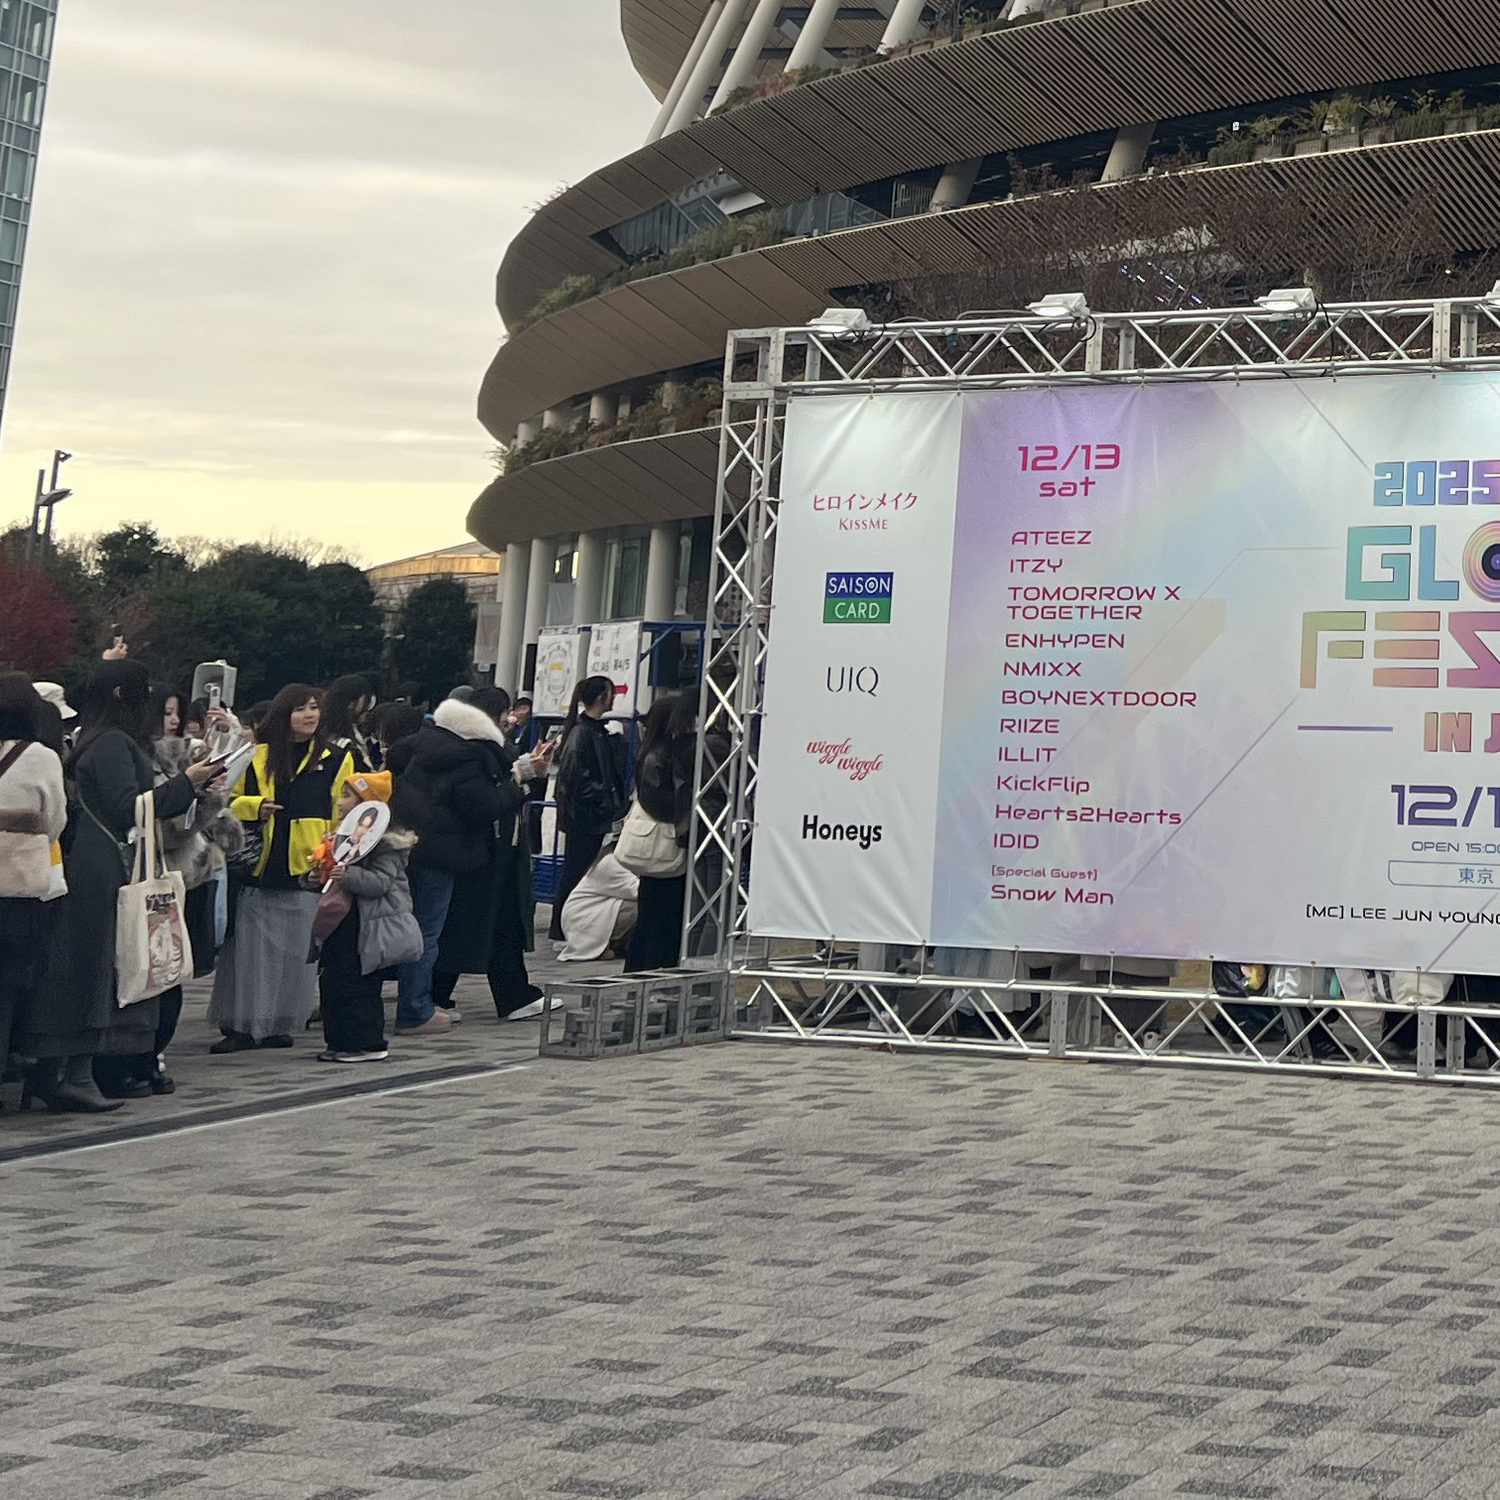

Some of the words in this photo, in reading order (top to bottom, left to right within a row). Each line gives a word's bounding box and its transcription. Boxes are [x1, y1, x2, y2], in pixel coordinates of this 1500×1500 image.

[1018, 444, 1121, 471] 12/13
[1039, 477, 1096, 498] sat
[813, 492, 918, 511] ヒロインメイク
[1012, 530, 1091, 546] ATEEZ
[1009, 558, 1063, 573] ITZY
[828, 576, 891, 595] SAISON
[1008, 585, 1157, 602] TOMORROW
[1164, 585, 1181, 601] X
[835, 602, 880, 619] CARD
[1007, 605, 1142, 621] TOGETHER
[1005, 633, 1125, 649] ENHYPEN
[1003, 662, 1081, 677] NMIXX
[1002, 690, 1196, 707] BOYNEXTDOOR
[1000, 719, 1060, 734] RIIZE
[1423, 712, 1472, 753] IN
[998, 747, 1057, 763] ILLIT
[997, 775, 1090, 795] KickFlip
[995, 805, 1181, 825] Hearts2Hearts
[802, 815, 882, 849] Honeys
[993, 833, 1038, 849] IDID
[1412, 842, 1460, 854] OPEN
[991, 886, 1056, 903] Snow
[1064, 888, 1114, 905] Man
[1306, 904, 1345, 920] [MC]
[1351, 907, 1386, 920] LEE
[1393, 908, 1433, 922] JUN
